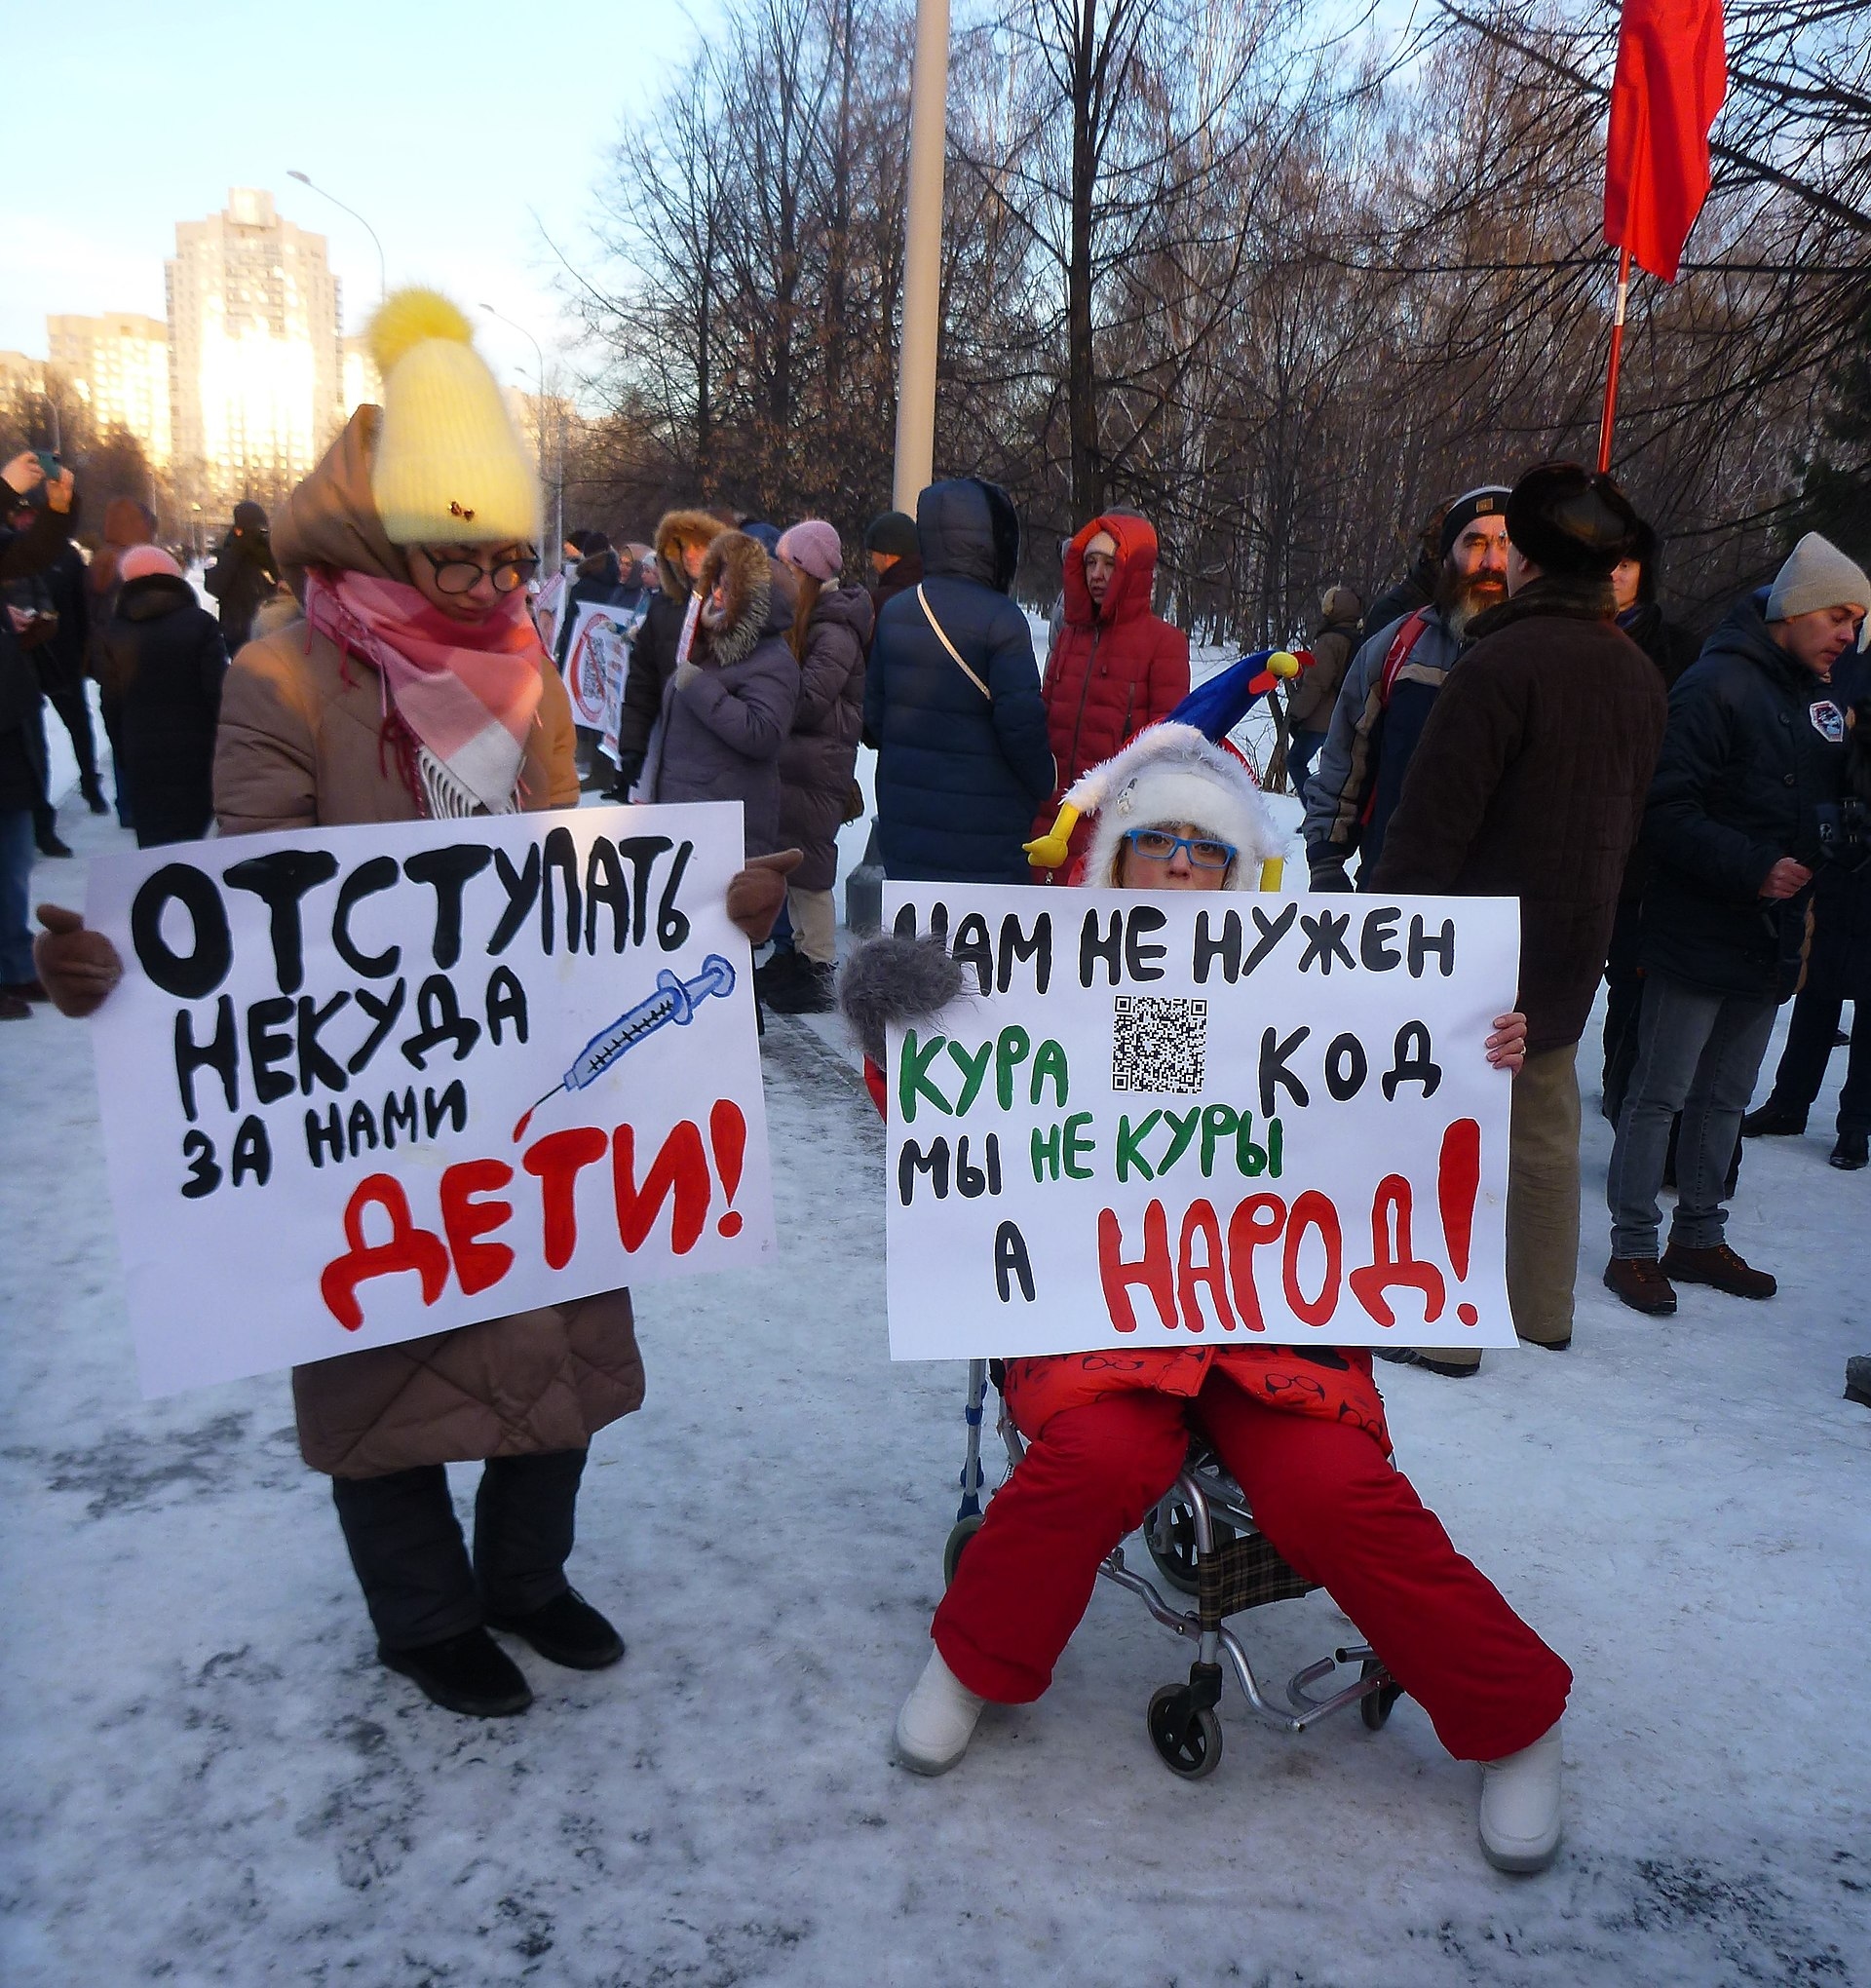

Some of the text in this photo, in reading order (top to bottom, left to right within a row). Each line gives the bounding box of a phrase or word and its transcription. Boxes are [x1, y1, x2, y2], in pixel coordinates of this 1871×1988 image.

[131, 826, 695, 1000] ОТСТУПАТЬ
[1078, 905, 1169, 988] НЕ
[1193, 901, 1457, 985] НУЖЕН
[173, 965, 530, 1123] НЕКУДА
[897, 1018, 1443, 1125] КУРА КОД
[180, 1079, 469, 1200] ЗА НАМИ
[897, 1102, 1284, 1207] МЫ НЕ КУРЫ
[320, 1098, 747, 1332] ДЕТИ!
[994, 1117, 1482, 1334] А НАРОД!
